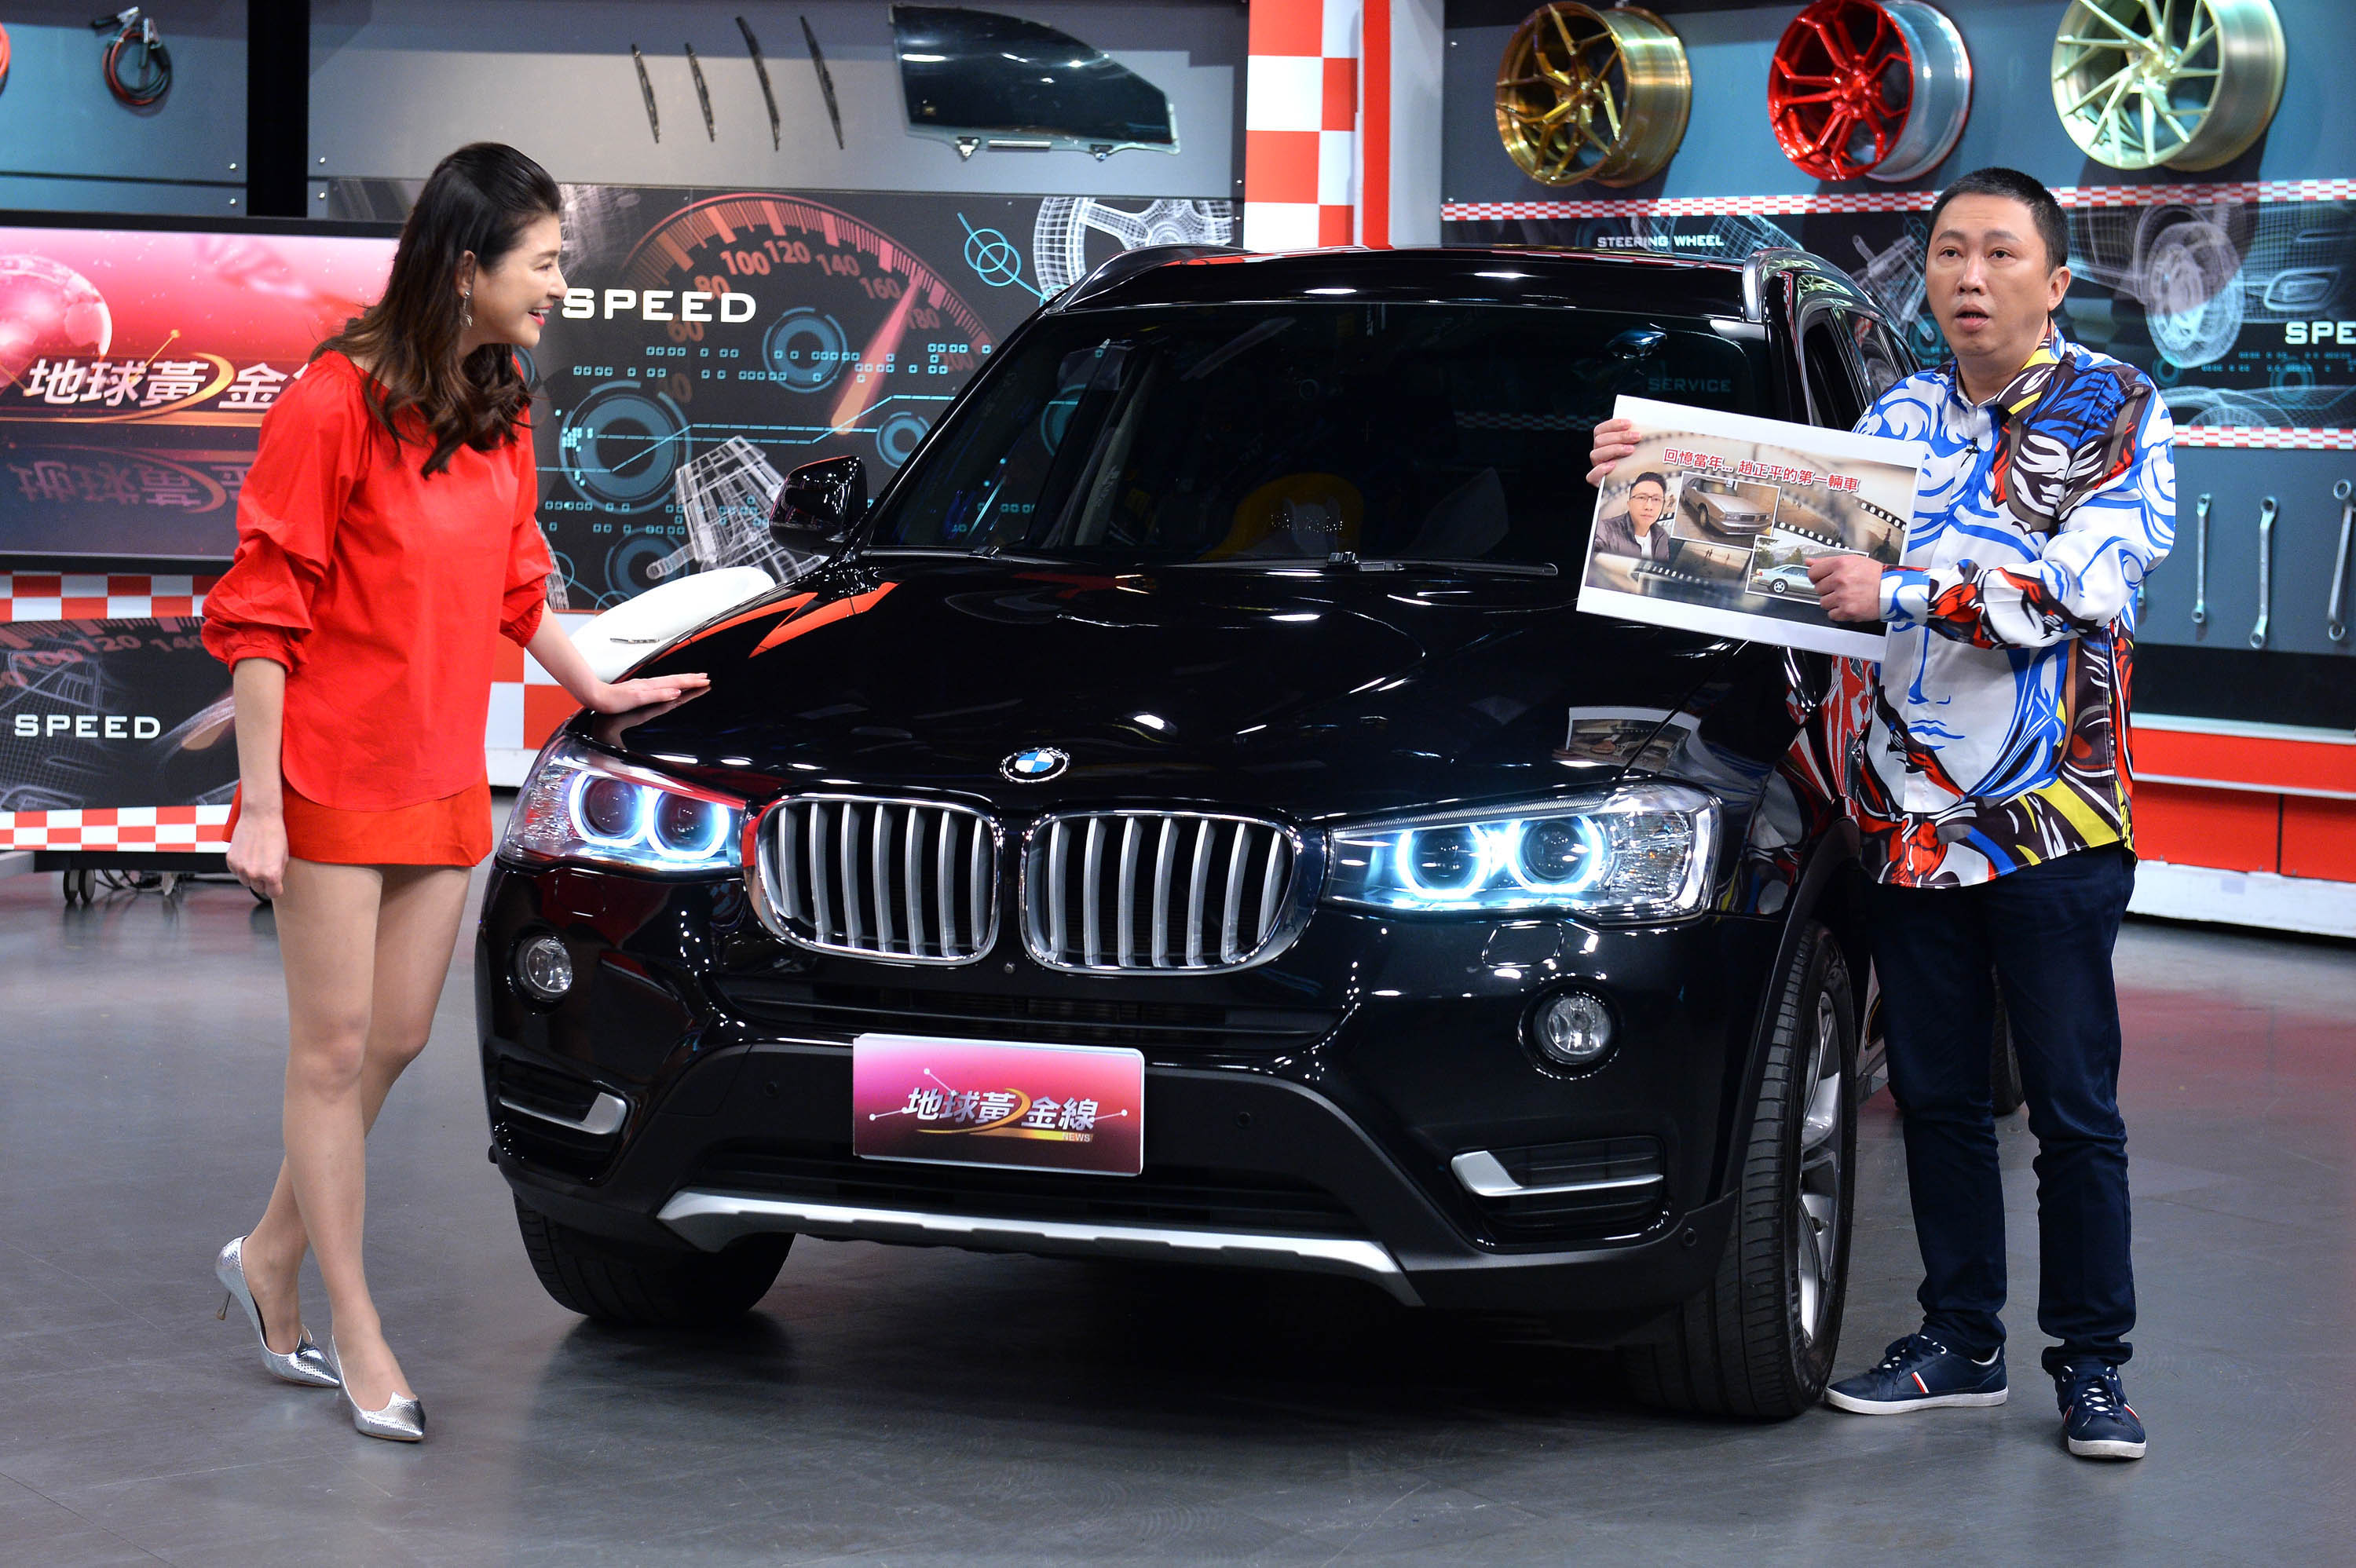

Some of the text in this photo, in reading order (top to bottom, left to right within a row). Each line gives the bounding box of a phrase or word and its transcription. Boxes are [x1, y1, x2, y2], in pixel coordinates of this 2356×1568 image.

[763, 240, 811, 264] 120
[1597, 235, 1725, 248] STEERING WHEEL
[719, 250, 771, 276] 100
[816, 253, 861, 276] 140
[859, 276, 902, 299] 160
[562, 287, 756, 323] SPEED
[28, 358, 309, 410] 地球黃金
[1648, 377, 1732, 393] SERVICE
[1737, 459, 1860, 492] 趙正平的第一輛車
[75, 634, 142, 653] 120
[14, 714, 162, 740] SPEED
[902, 1087, 1099, 1131] 地球黃金線
[1062, 1131, 1091, 1143] NEWS
